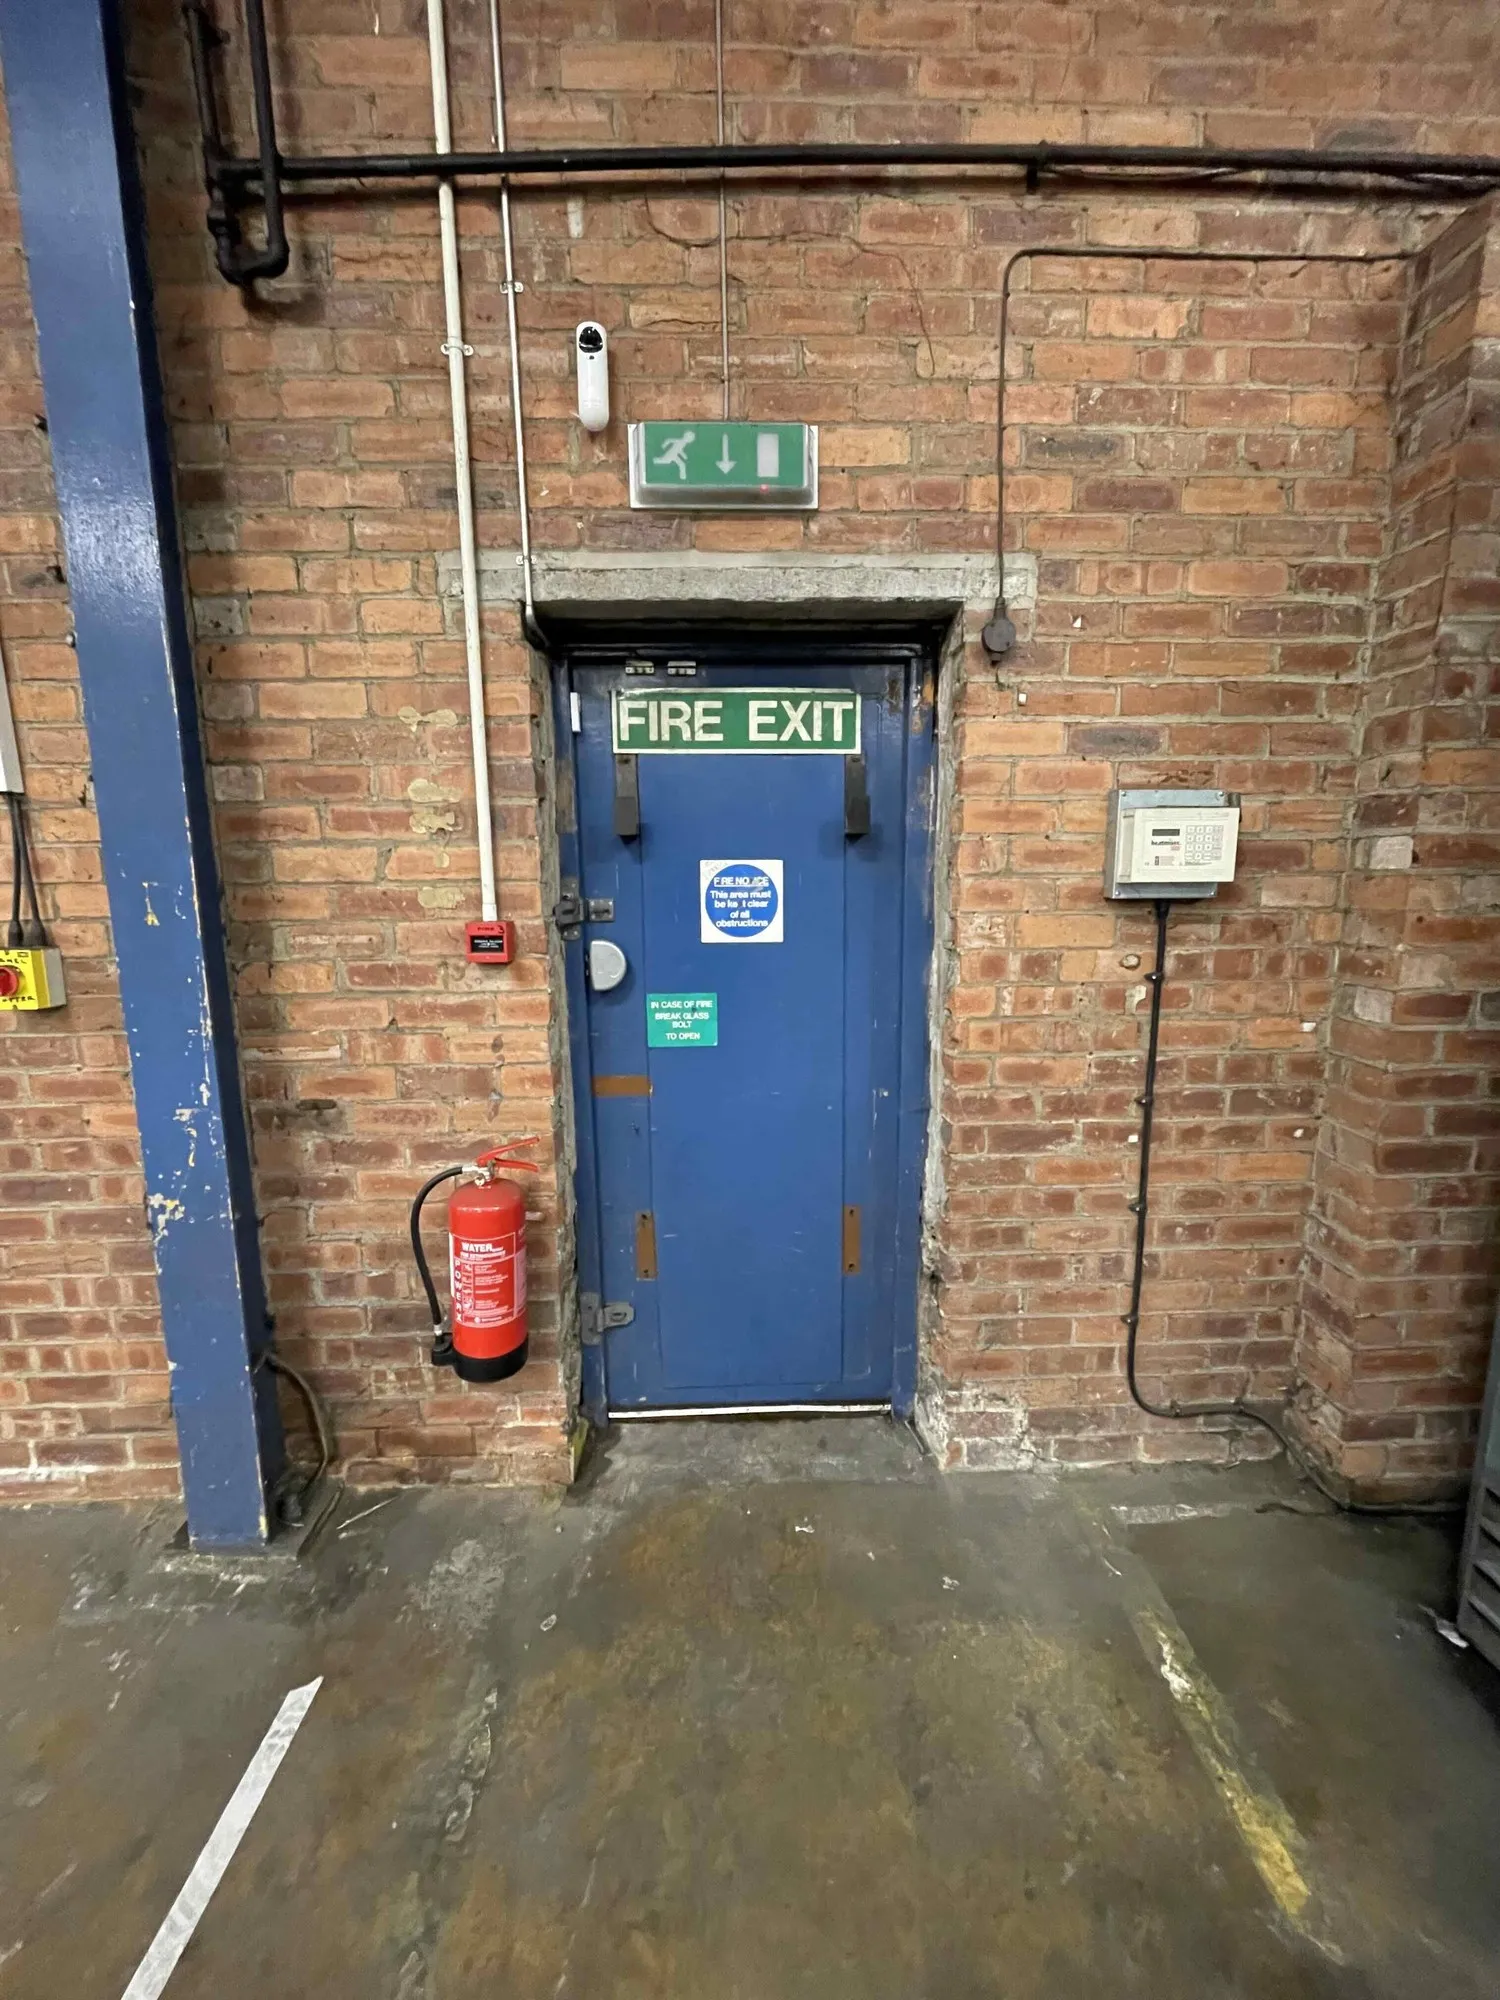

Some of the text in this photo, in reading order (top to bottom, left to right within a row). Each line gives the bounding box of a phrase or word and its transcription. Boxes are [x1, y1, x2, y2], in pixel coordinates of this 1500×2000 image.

[619, 700, 853, 741] FIRE EXIT
[713, 876, 734, 885] FRE
[710, 890, 772, 899] This area must
[714, 900, 769, 908] be ket clear
[729, 910, 750, 919] of all
[716, 919, 769, 927] obstructions
[650, 1000, 713, 1009] IN CASE OF FIRE
[655, 1012, 710, 1020] BREAK GLASS
[672, 1020, 692, 1028] BOLT
[665, 1032, 701, 1040] TO OPEN
[461, 1242, 493, 1252] WATER
